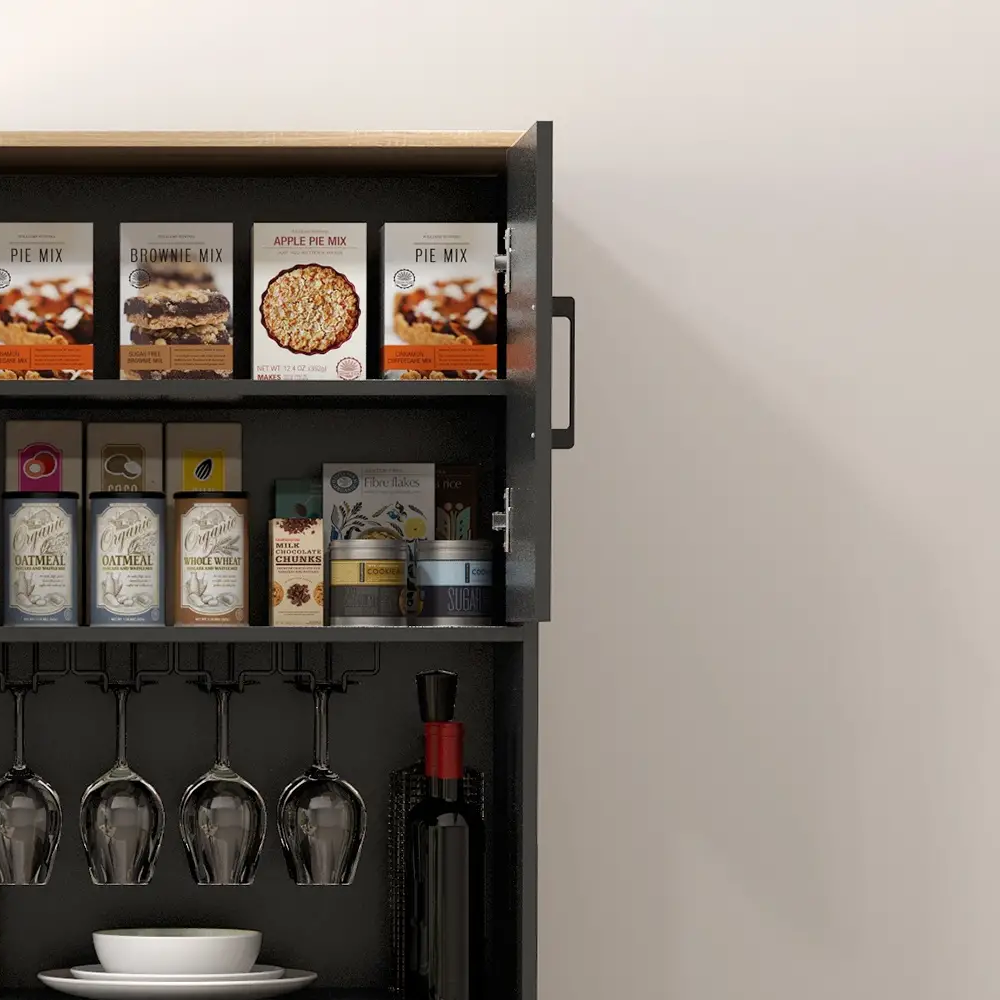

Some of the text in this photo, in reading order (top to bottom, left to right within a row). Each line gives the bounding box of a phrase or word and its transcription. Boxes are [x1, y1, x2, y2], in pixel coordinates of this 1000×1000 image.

[273, 236, 347, 246] APPLE PIE MIX
[10, 248, 63, 263] PIE MIX
[130, 248, 223, 263] BROWNIE MIX
[415, 248, 468, 263] PIE MIX
[364, 476, 390, 488] Fibre
[392, 476, 420, 488] flakes
[12, 516, 65, 552] Organic
[100, 516, 153, 552] Organic
[184, 516, 237, 552] Organic
[14, 555, 66, 566] OATMEAL
[102, 555, 154, 566] OATMEAL
[184, 556, 242, 566] WHOLE WHEAT
[275, 555, 322, 563] CHUNKS
